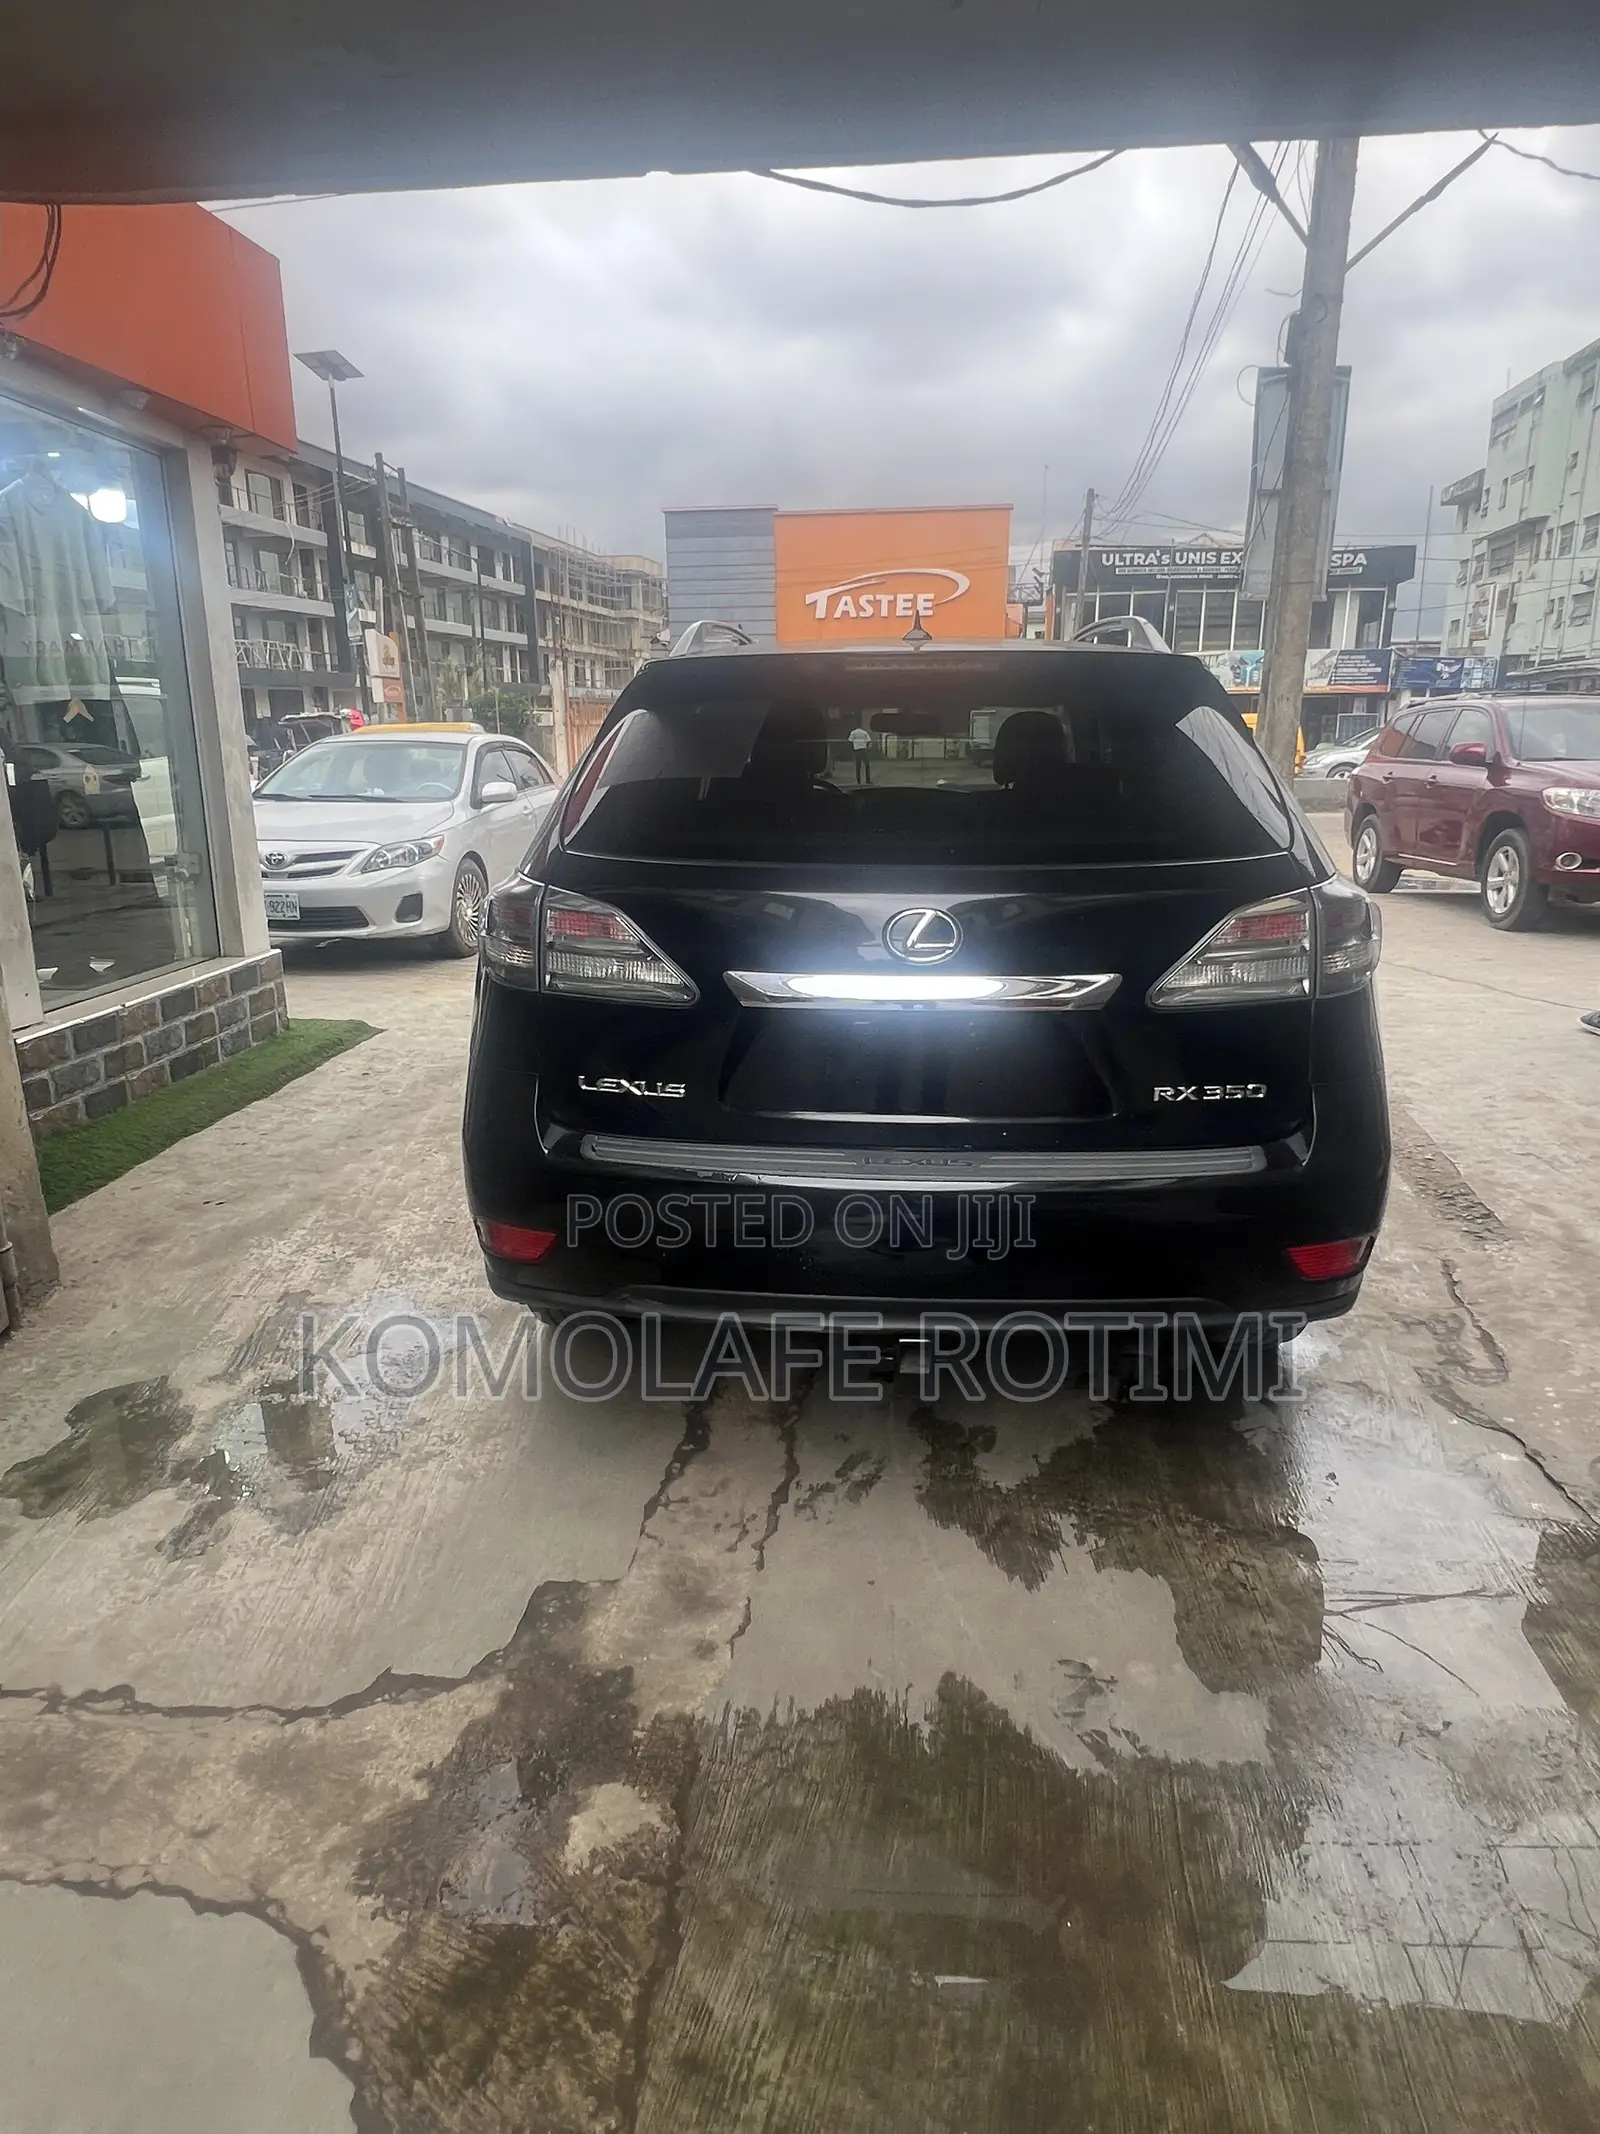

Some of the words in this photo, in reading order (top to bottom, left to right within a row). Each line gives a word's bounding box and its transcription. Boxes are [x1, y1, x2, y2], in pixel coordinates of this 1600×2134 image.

[1101, 550, 1170, 566] ULTRA's
[1330, 553, 1368, 567] SPA
[805, 592, 936, 620] TASTEE
[577, 1075, 686, 1098] LEXUS
[1152, 1085, 1199, 1102] RX
[1202, 1083, 1268, 1100] 350
